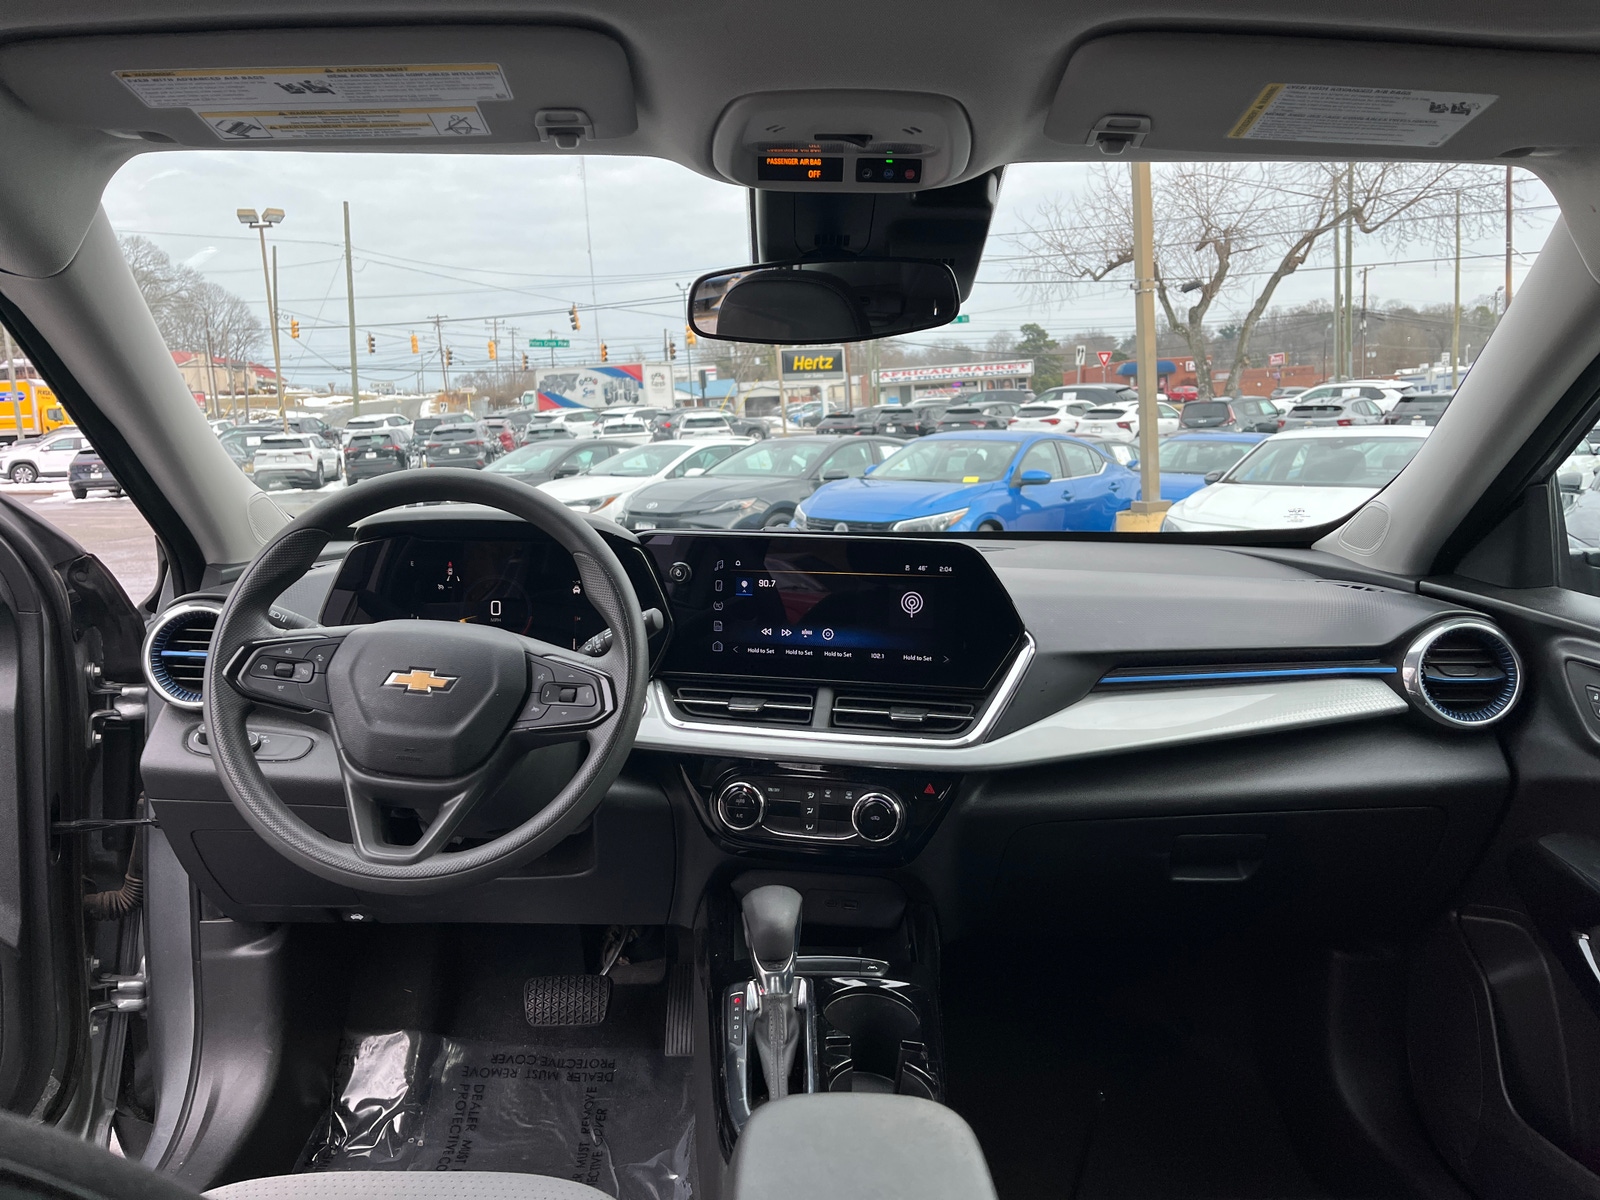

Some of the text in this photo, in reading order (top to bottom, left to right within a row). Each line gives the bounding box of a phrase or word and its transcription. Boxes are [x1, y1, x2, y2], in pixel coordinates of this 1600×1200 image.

[766, 157, 822, 166] PASSENGER AIR BAG
[807, 169, 822, 179] OFF
[792, 354, 834, 371] Hertz
[880, 362, 1029, 379] AFRICAN MARKET
[917, 371, 978, 381] TROPICAL
[983, 369, 1020, 377] FOOD
[938, 565, 953, 573] 2:04
[758, 578, 776, 588] 90.7
[490, 600, 502, 616] 0
[747, 646, 776, 655] Hold to Set
[785, 648, 798, 656] Hold
[804, 649, 814, 657] Set
[824, 650, 837, 658] Hold
[843, 651, 852, 659] Set
[902, 654, 933, 663] Hold to Set
[490, 1053, 616, 1069] PROTECTIVE COVER
[461, 1065, 615, 1083] DEALER MUST REMOVE
[580, 1086, 598, 1135] REMOVE
[442, 1083, 471, 1155] PROTECTIVE
[455, 1083, 486, 1165] DEALER MUST
[593, 1108, 608, 1147] COVER
[576, 1142, 591, 1169] MUST
